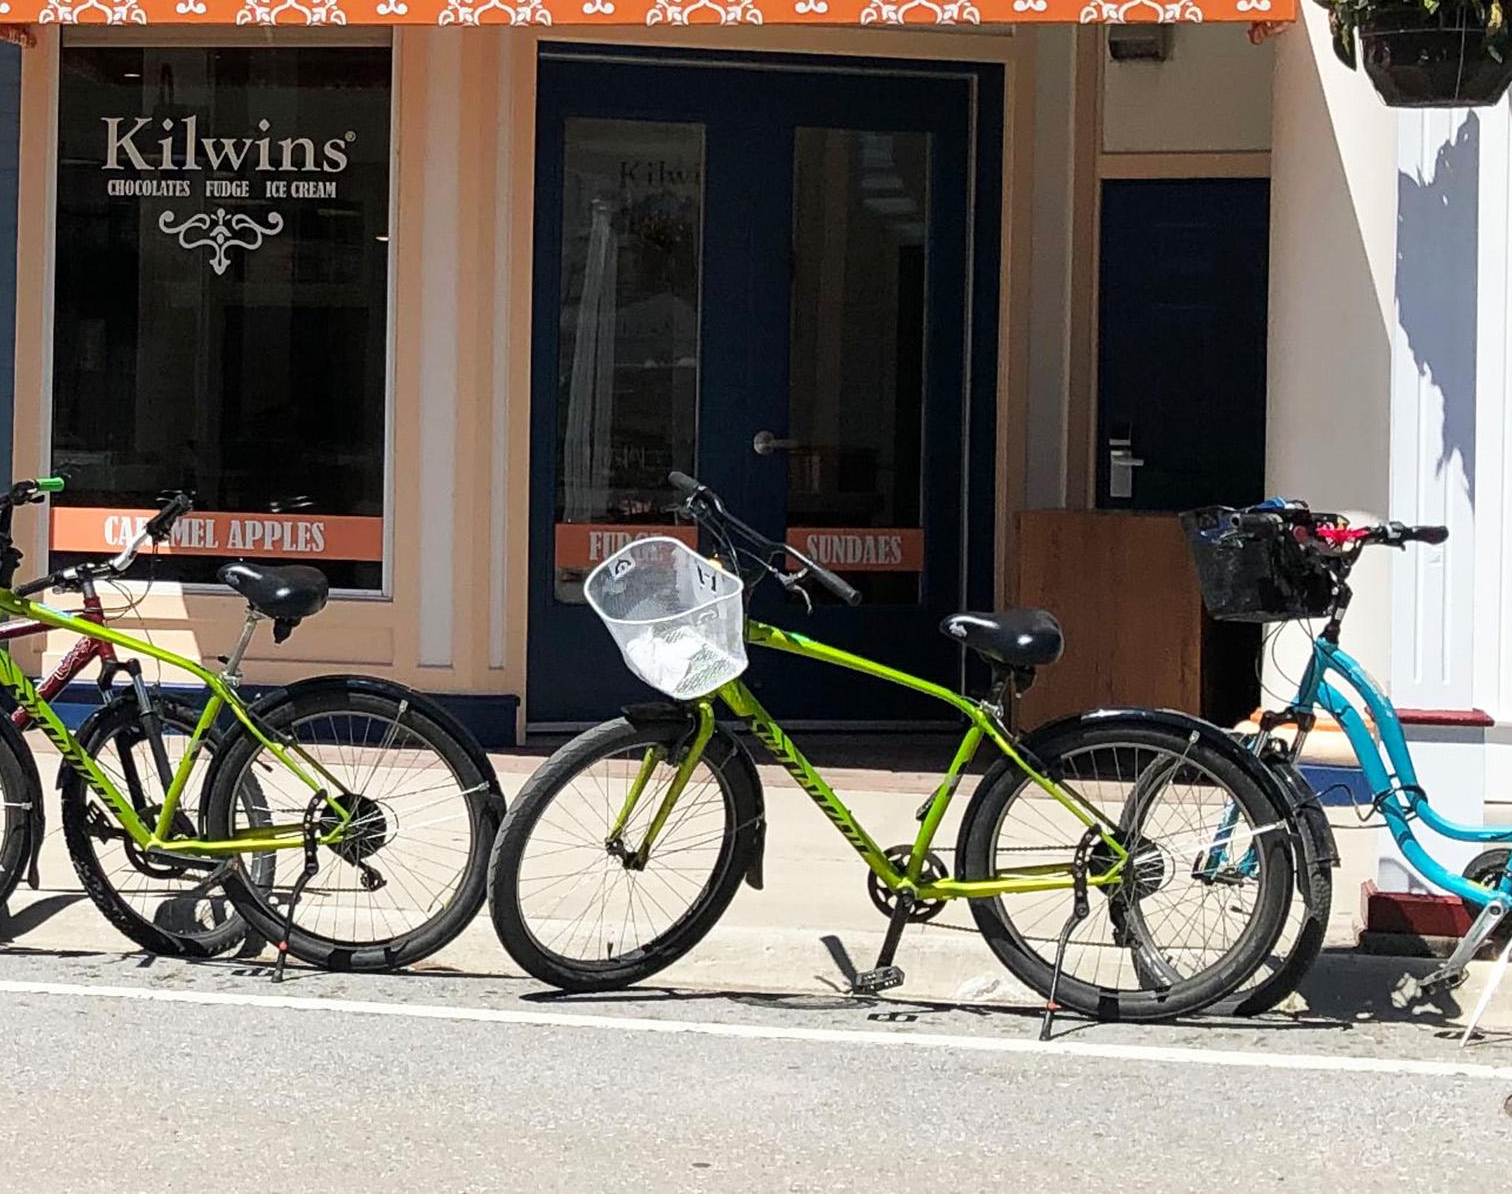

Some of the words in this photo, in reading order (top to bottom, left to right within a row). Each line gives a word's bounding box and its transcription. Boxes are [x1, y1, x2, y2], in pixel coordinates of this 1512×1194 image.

[107, 179, 191, 197] CHOCOLATES
[205, 180, 250, 198] FUDGE
[266, 181, 287, 198] ICE
[291, 181, 337, 199] CREAM
[227, 519, 325, 553] APPLES
[806, 533, 903, 565] SUNDAES
